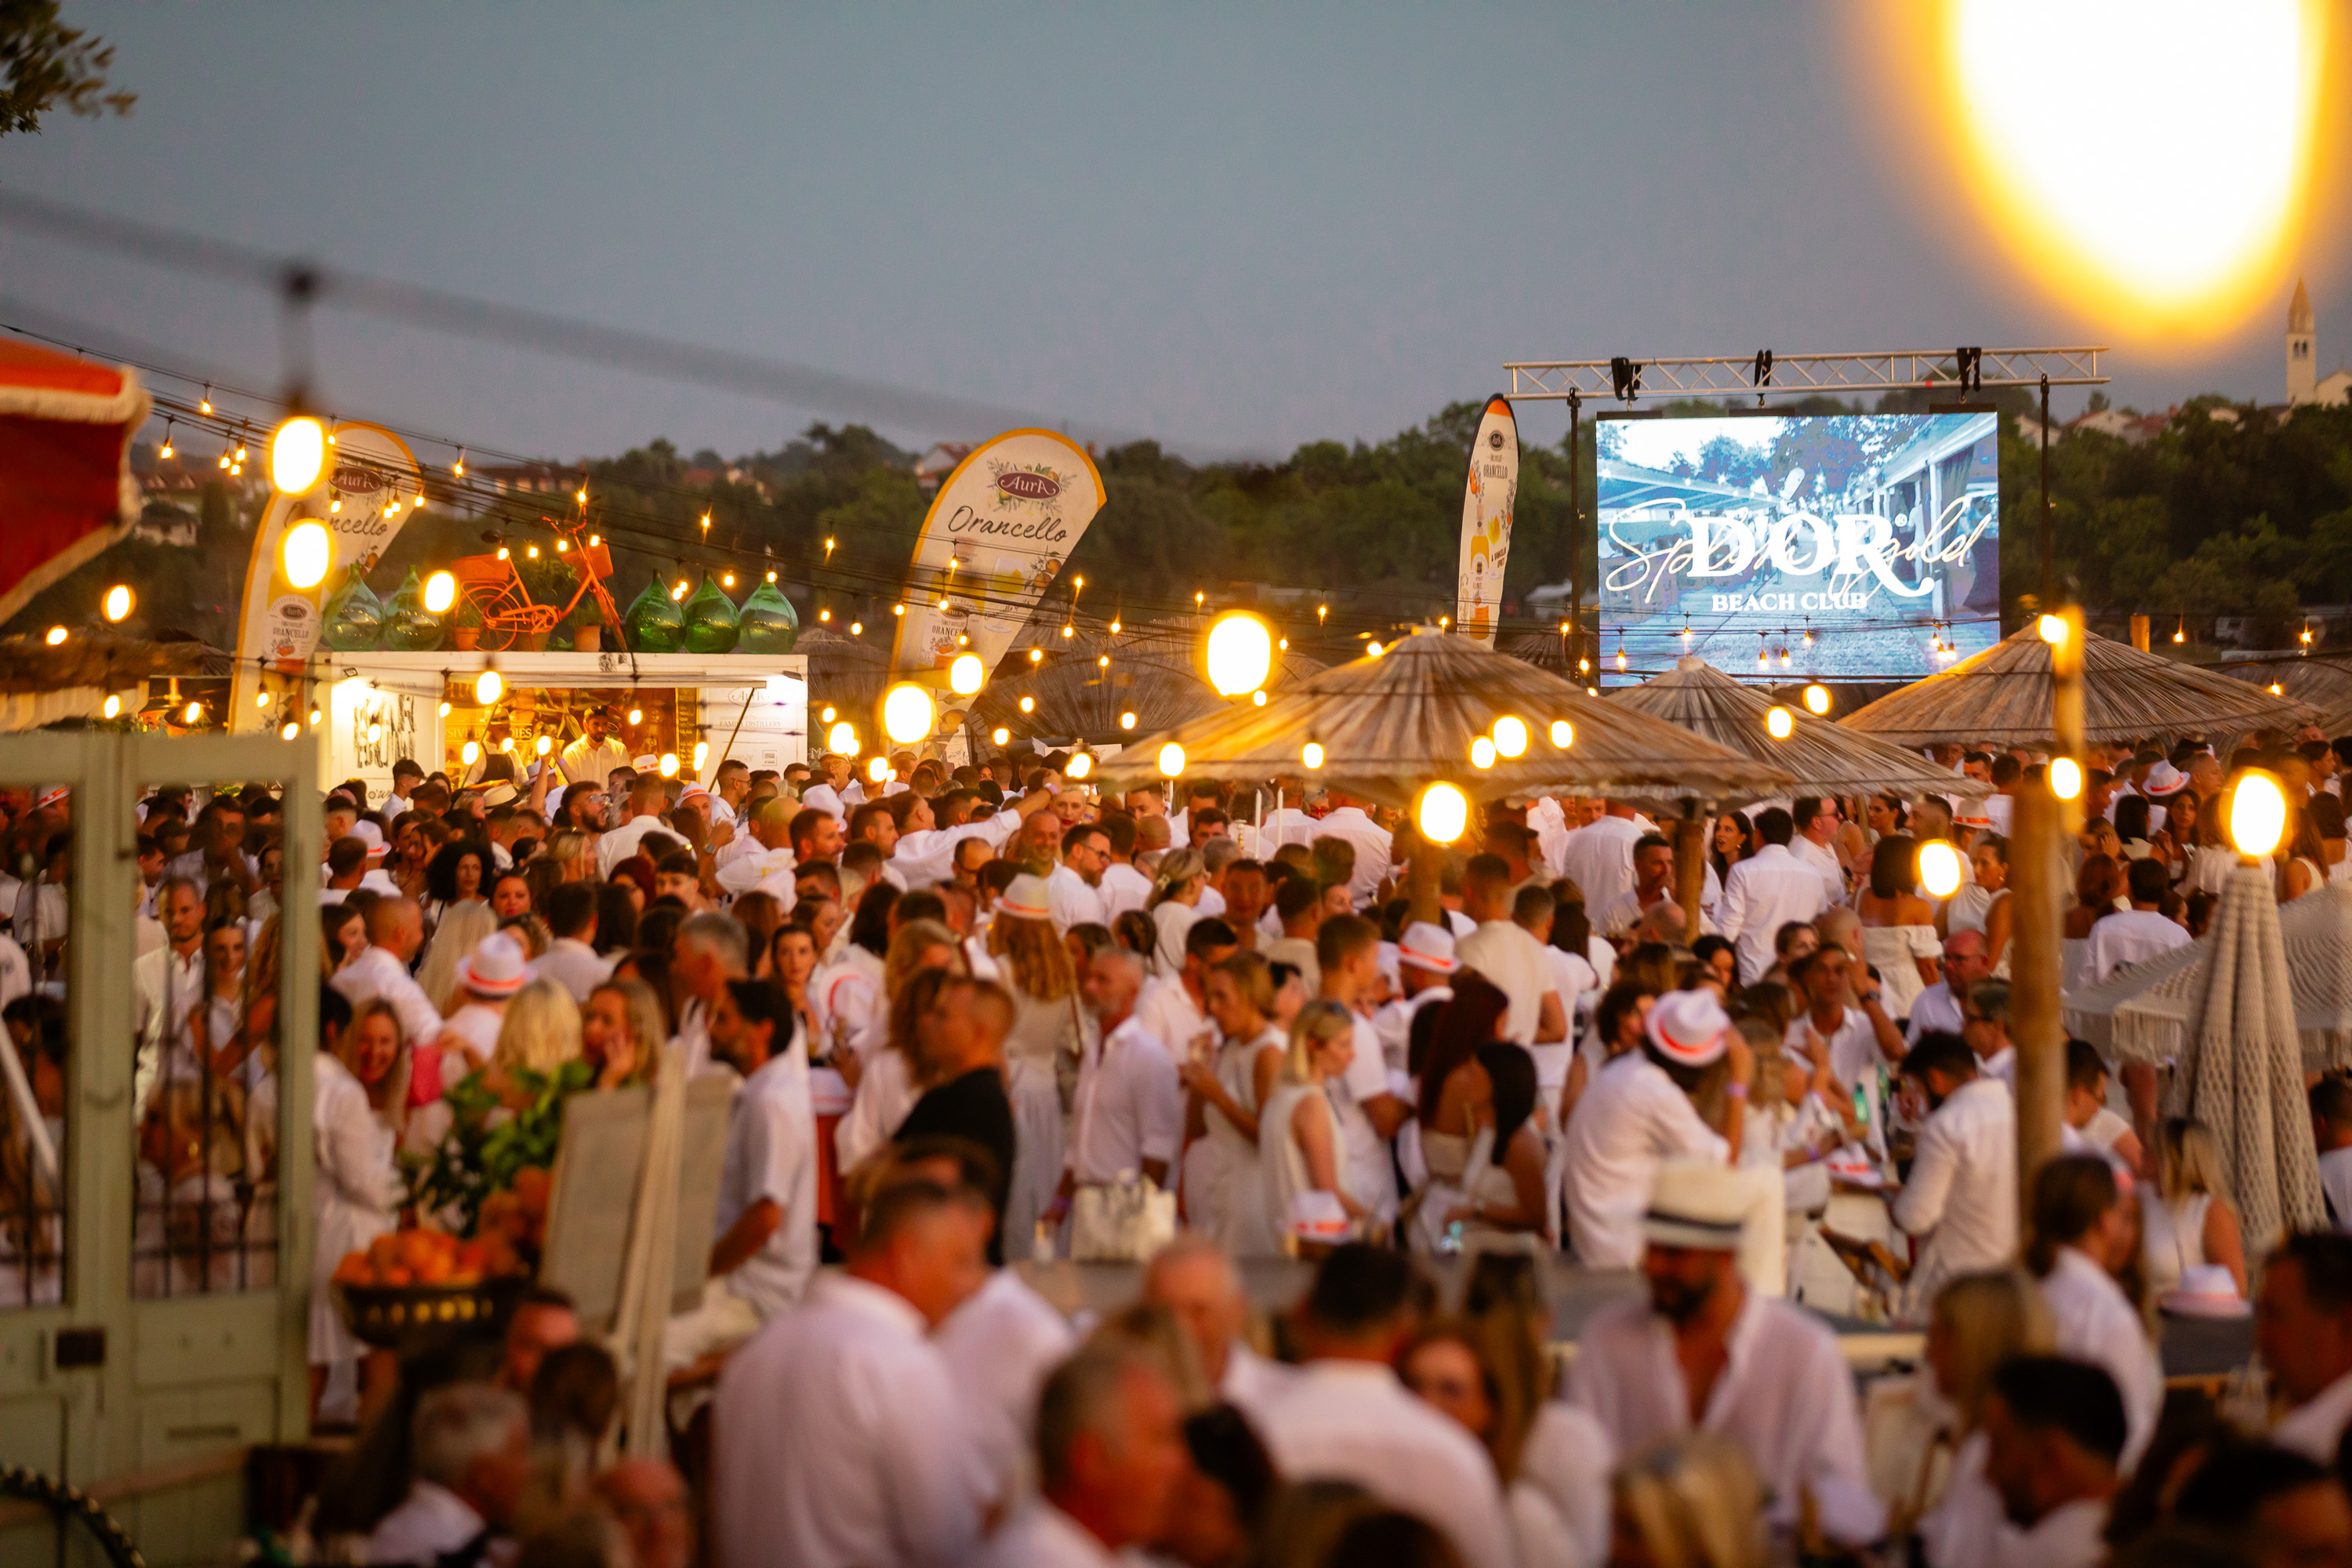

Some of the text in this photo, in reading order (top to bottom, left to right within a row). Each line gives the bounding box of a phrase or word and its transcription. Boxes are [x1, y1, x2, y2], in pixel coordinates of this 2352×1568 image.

[1483, 464, 1508, 479] ORANCELLO
[1000, 476, 1056, 495] AurA
[948, 505, 1068, 542] Orancello
[1711, 591, 1867, 612] BEACH CLUB
